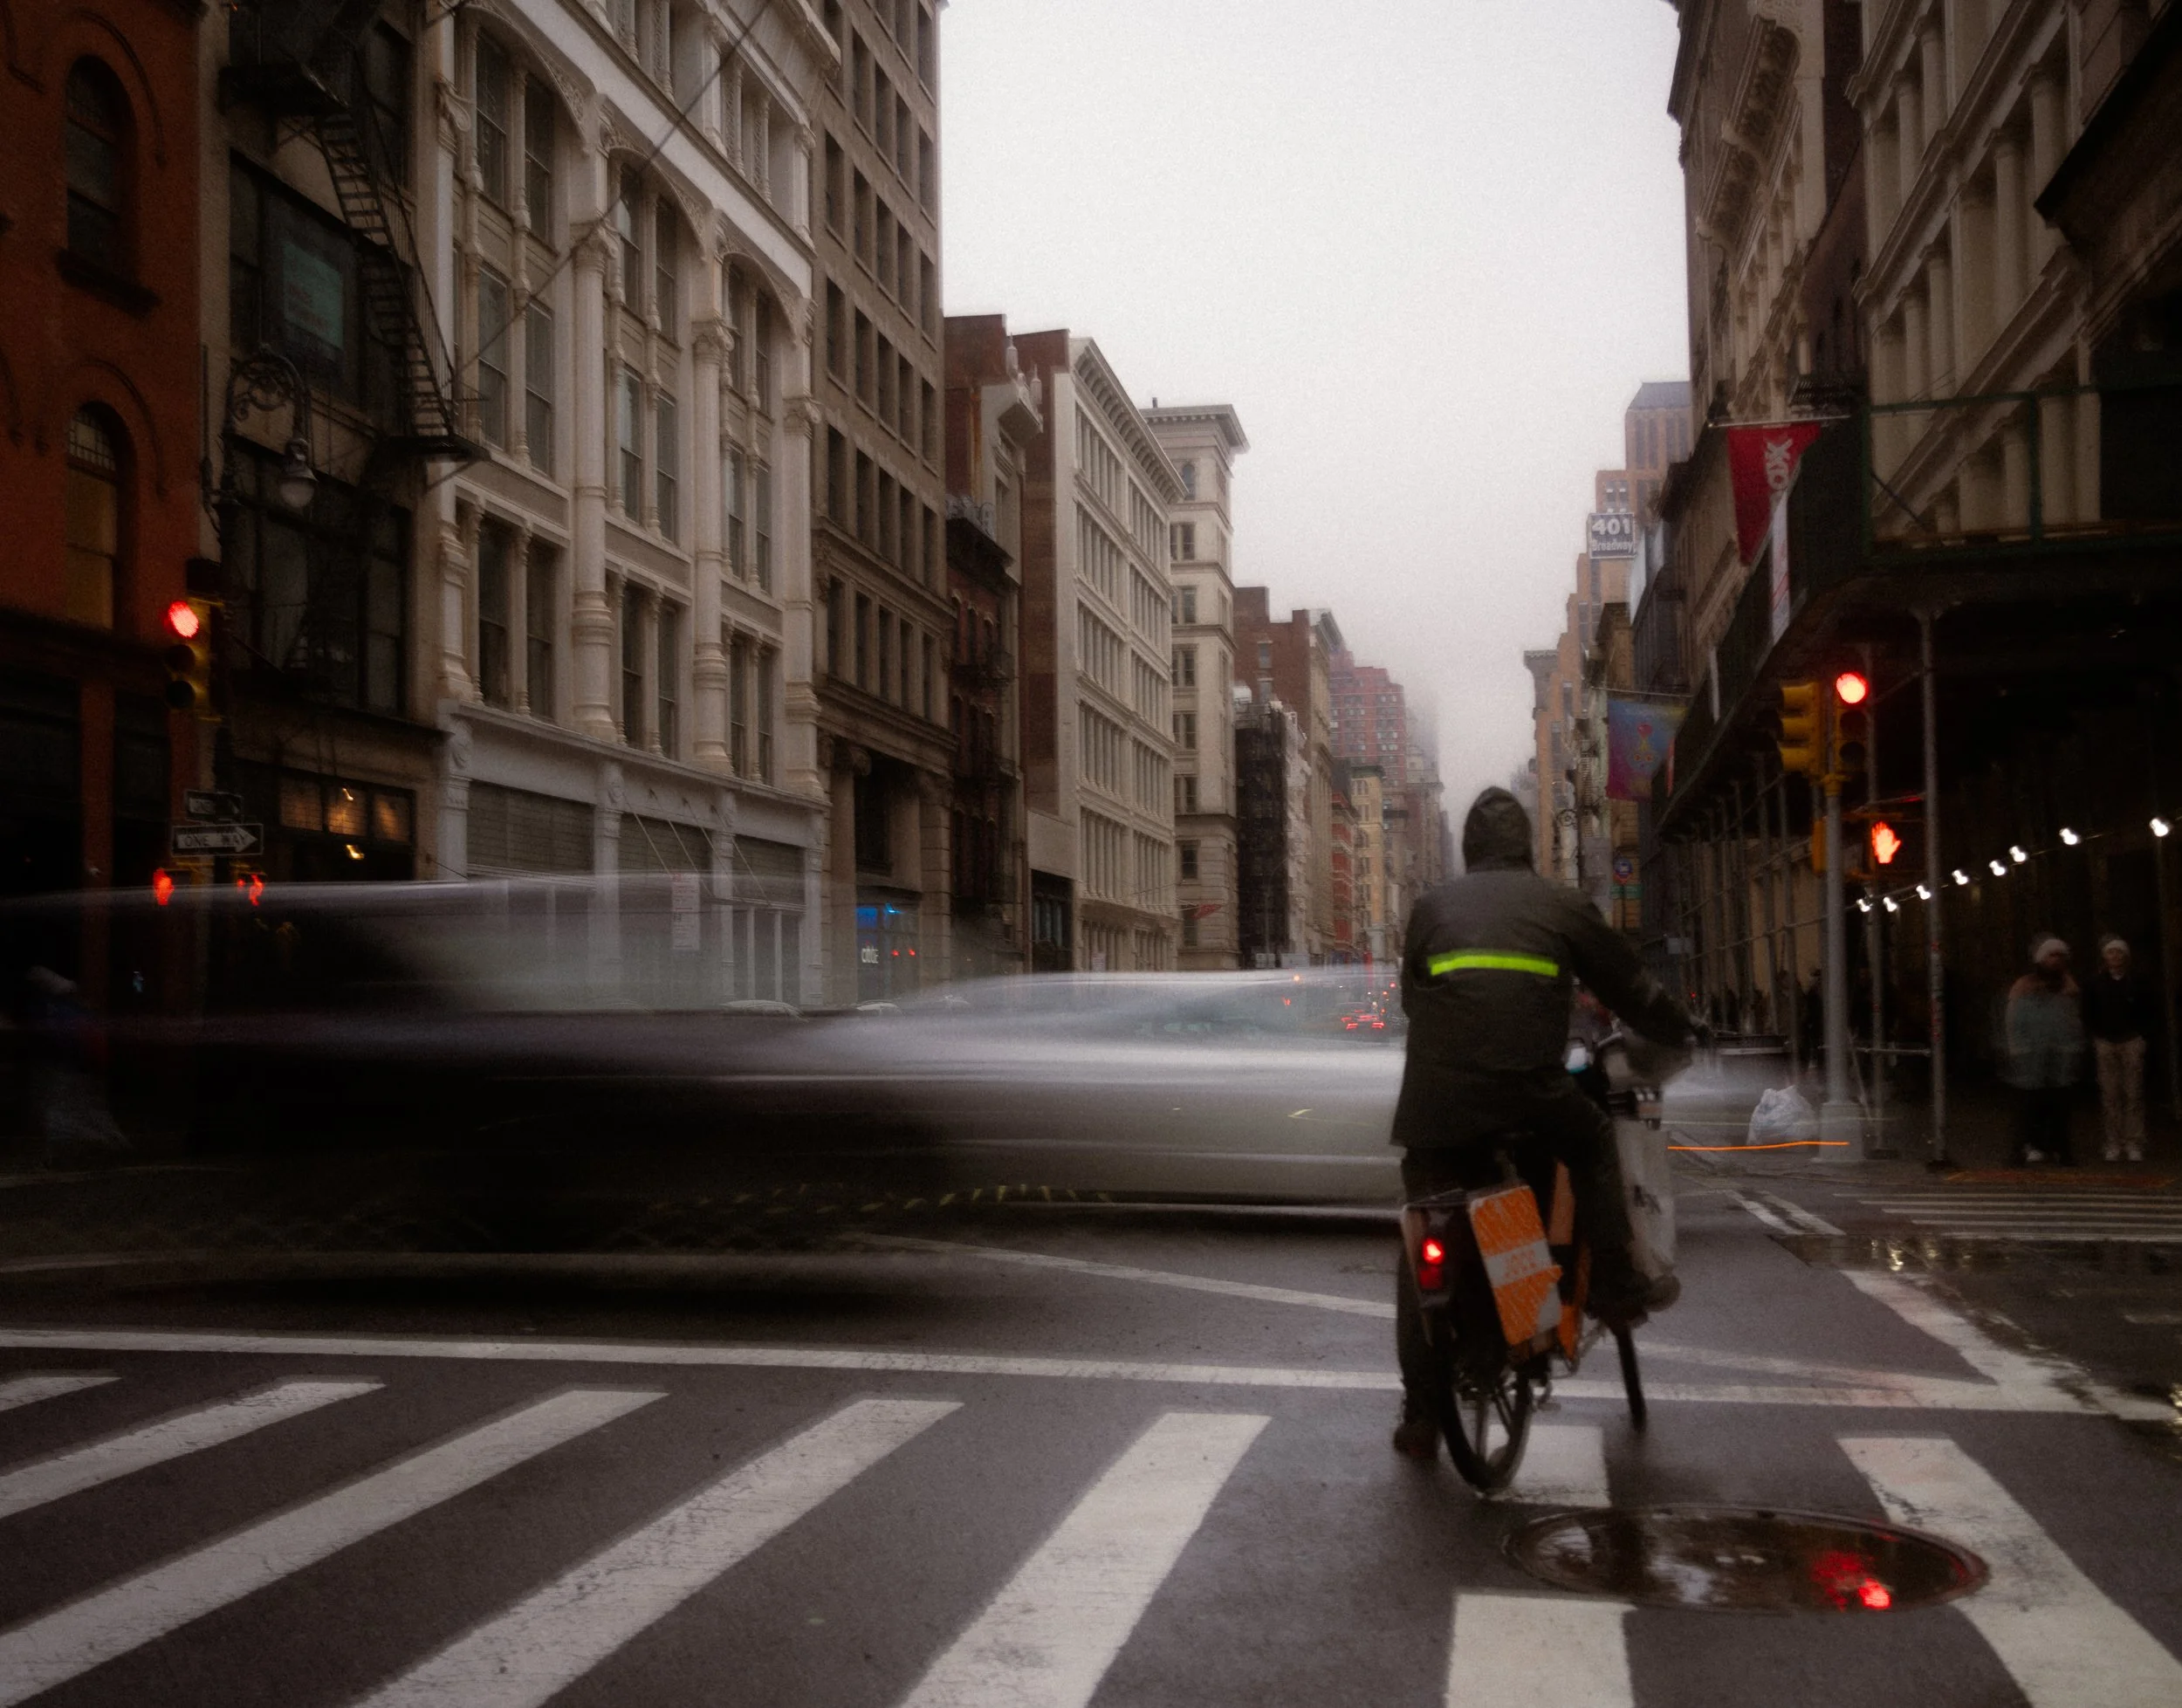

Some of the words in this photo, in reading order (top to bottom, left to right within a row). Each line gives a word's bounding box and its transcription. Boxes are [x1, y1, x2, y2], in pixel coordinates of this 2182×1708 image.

[1591, 518, 1631, 536] 401
[1590, 538, 1634, 553] Broadway
[184, 834, 210, 847] ONE
[221, 833, 247, 847] WAY
